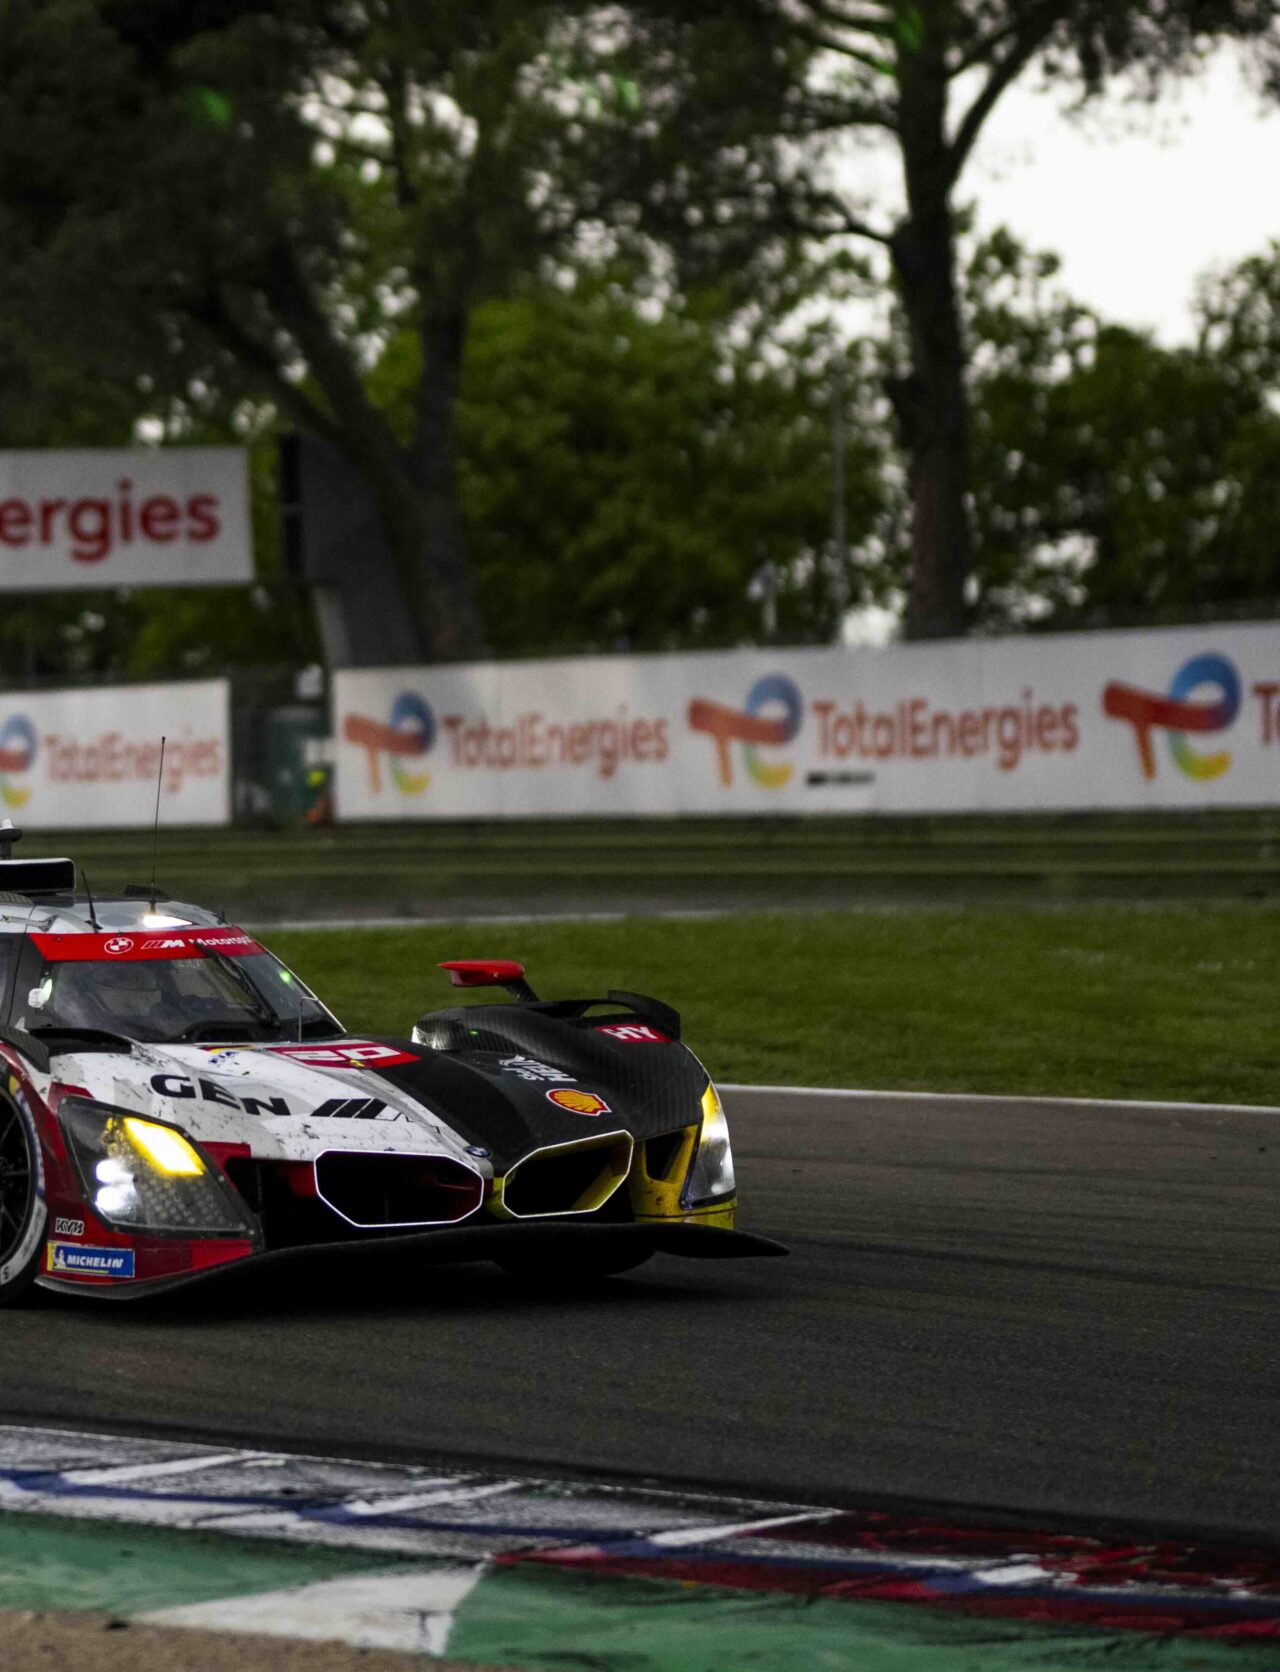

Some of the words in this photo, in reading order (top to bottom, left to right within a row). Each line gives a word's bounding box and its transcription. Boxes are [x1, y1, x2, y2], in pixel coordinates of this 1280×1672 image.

[442, 703, 669, 779] TotalEnergies
[812, 685, 1079, 771] TotalEnergies
[151, 1074, 291, 1116] GEN
[56, 1218, 84, 1235] KYB
[67, 1254, 124, 1269] MICHELIN
